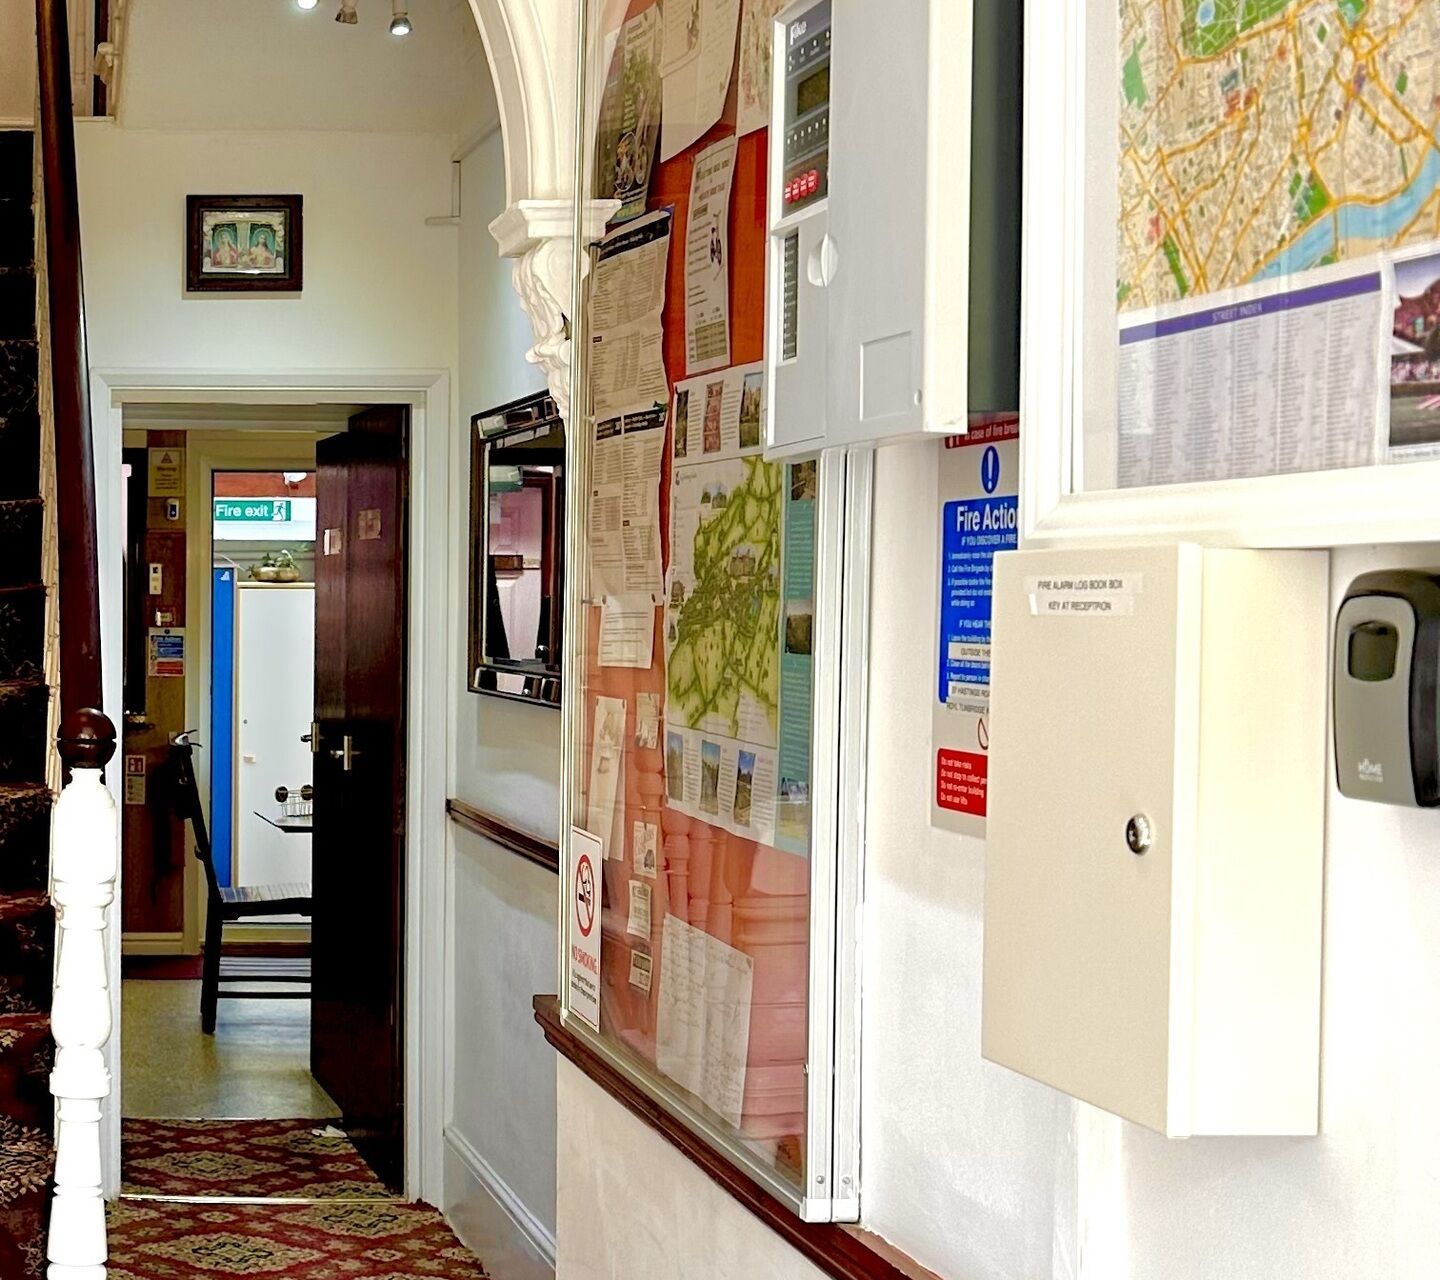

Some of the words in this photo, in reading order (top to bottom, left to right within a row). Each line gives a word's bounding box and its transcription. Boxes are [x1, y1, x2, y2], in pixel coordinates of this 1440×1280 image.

[215, 504, 242, 518] Fire
[245, 504, 269, 518] exit
[957, 505, 980, 532] Fire
[982, 502, 1019, 531] Actio
[1037, 581, 1052, 590] FIRE
[1053, 581, 1073, 590] ALARM
[1075, 580, 1088, 590] LOG
[1089, 580, 1107, 590] BOOK
[1108, 579, 1122, 589] BOX
[1048, 601, 1061, 610] KEY
[1062, 601, 1071, 610] AT
[1071, 602, 1111, 611] RECEPTION
[961, 648, 981, 656] OUTSIDE
